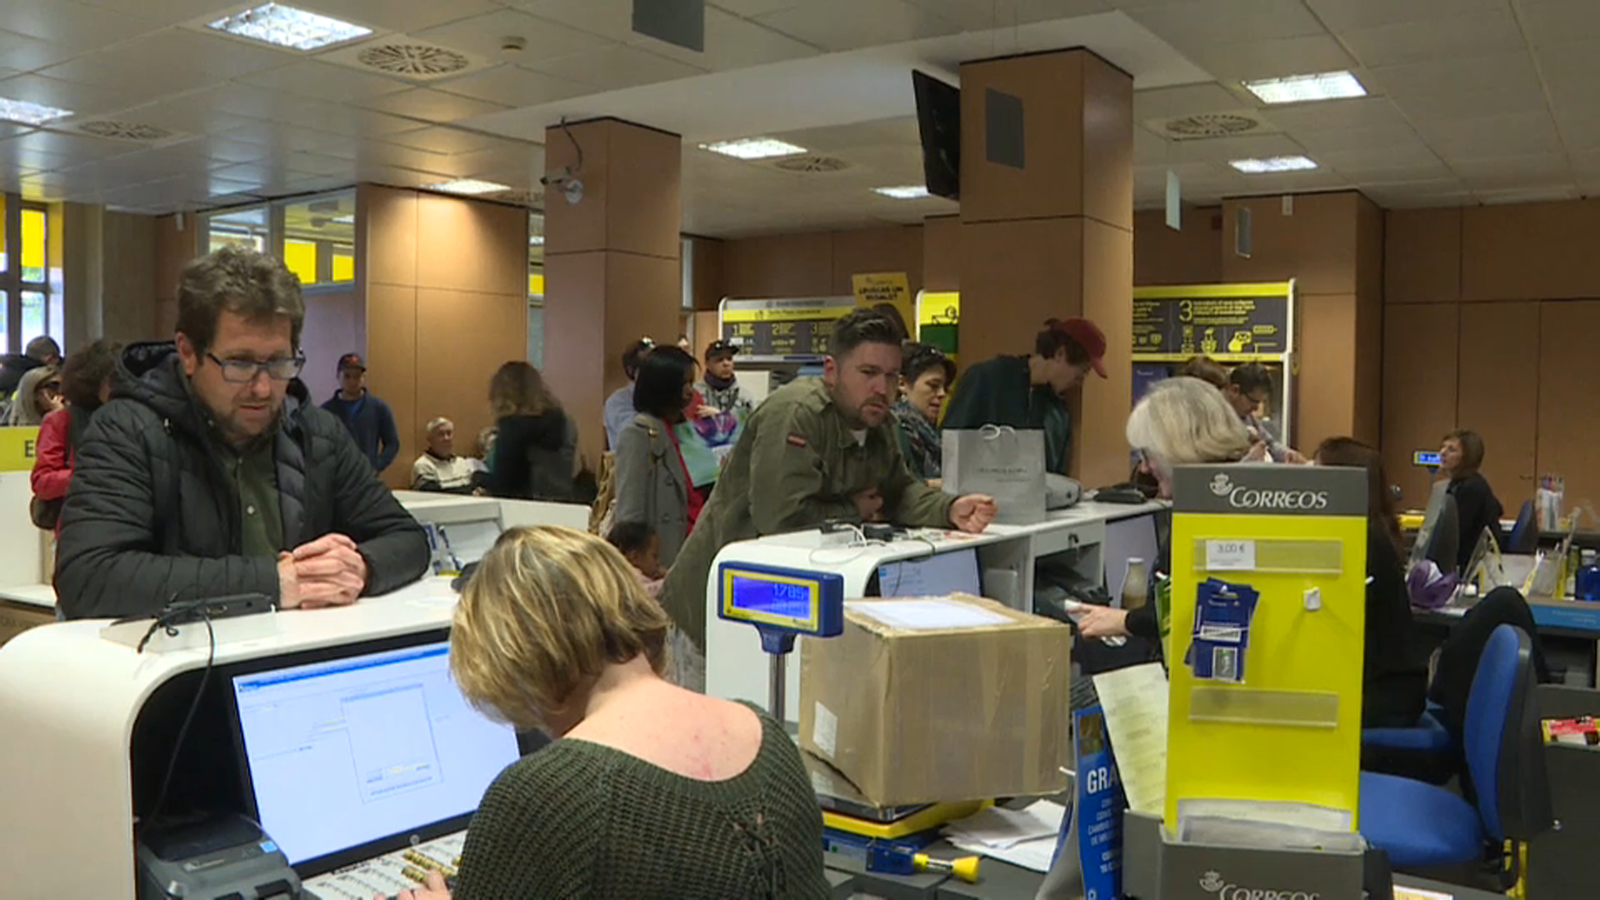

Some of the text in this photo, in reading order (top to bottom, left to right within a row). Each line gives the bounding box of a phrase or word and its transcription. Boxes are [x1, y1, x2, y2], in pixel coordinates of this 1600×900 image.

[1179, 300, 1193, 321] 3
[24, 440, 37, 457] E
[1229, 486, 1328, 509] CORREOS
